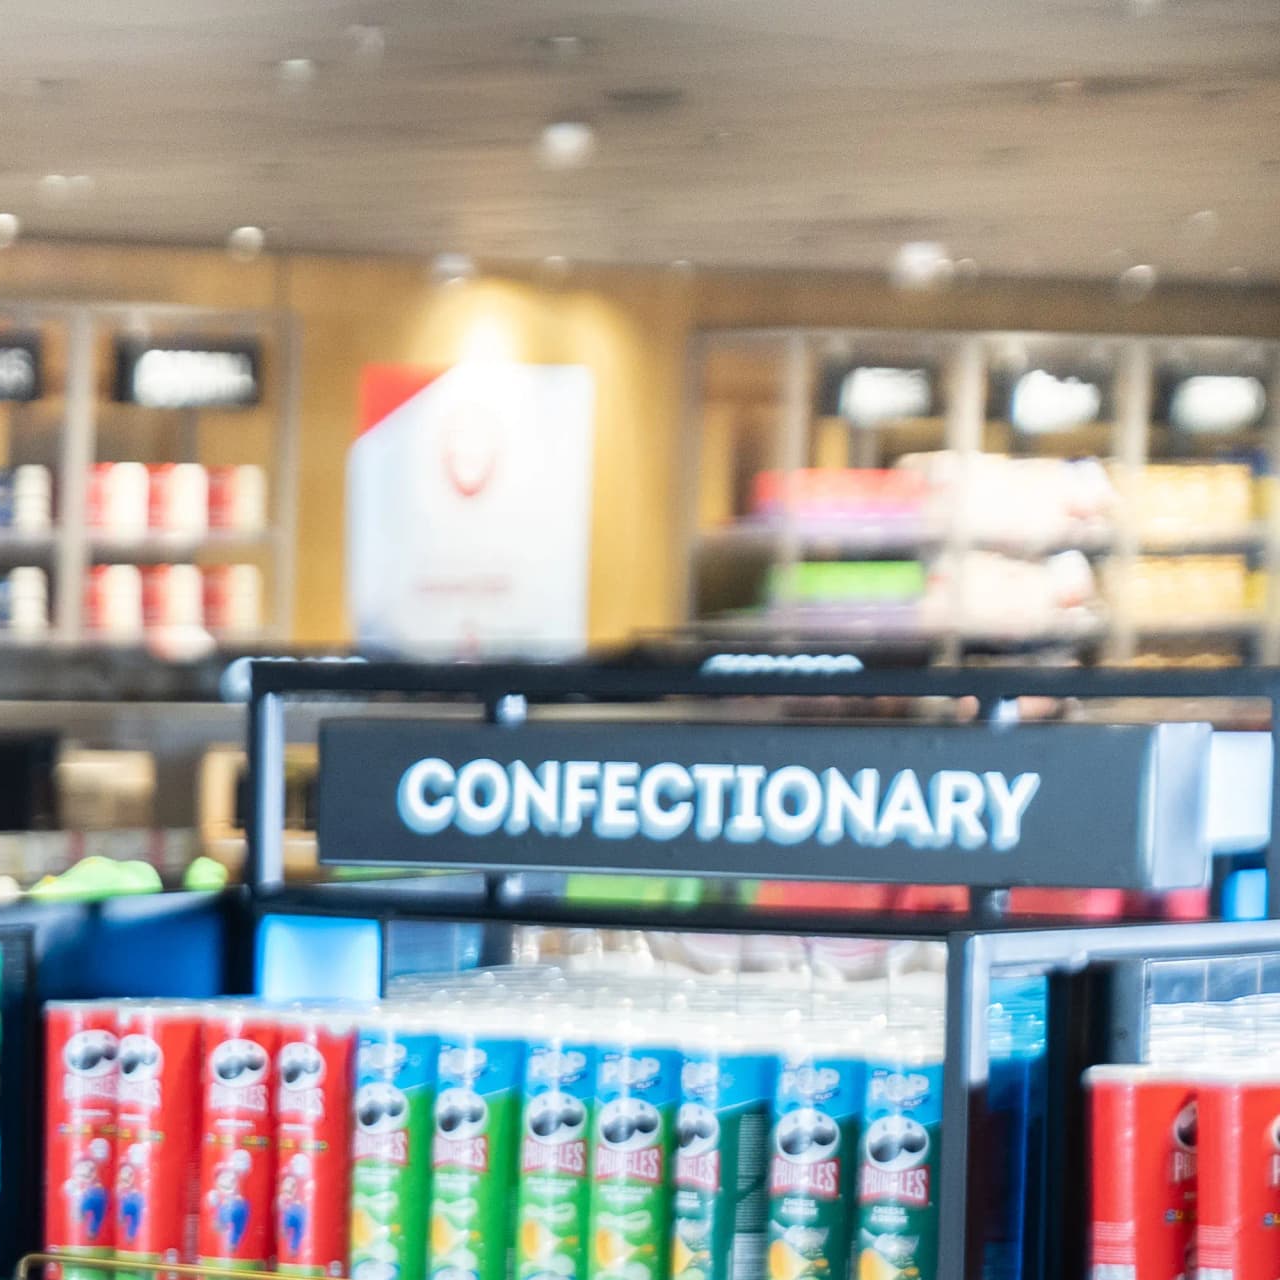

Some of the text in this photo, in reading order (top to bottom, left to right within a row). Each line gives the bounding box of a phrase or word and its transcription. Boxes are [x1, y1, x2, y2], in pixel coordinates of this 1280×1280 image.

[398, 757, 1040, 850] CONFECTIONARY
[773, 1156, 838, 1197] PRINGLES
[862, 1163, 925, 1204] PRINGLES
